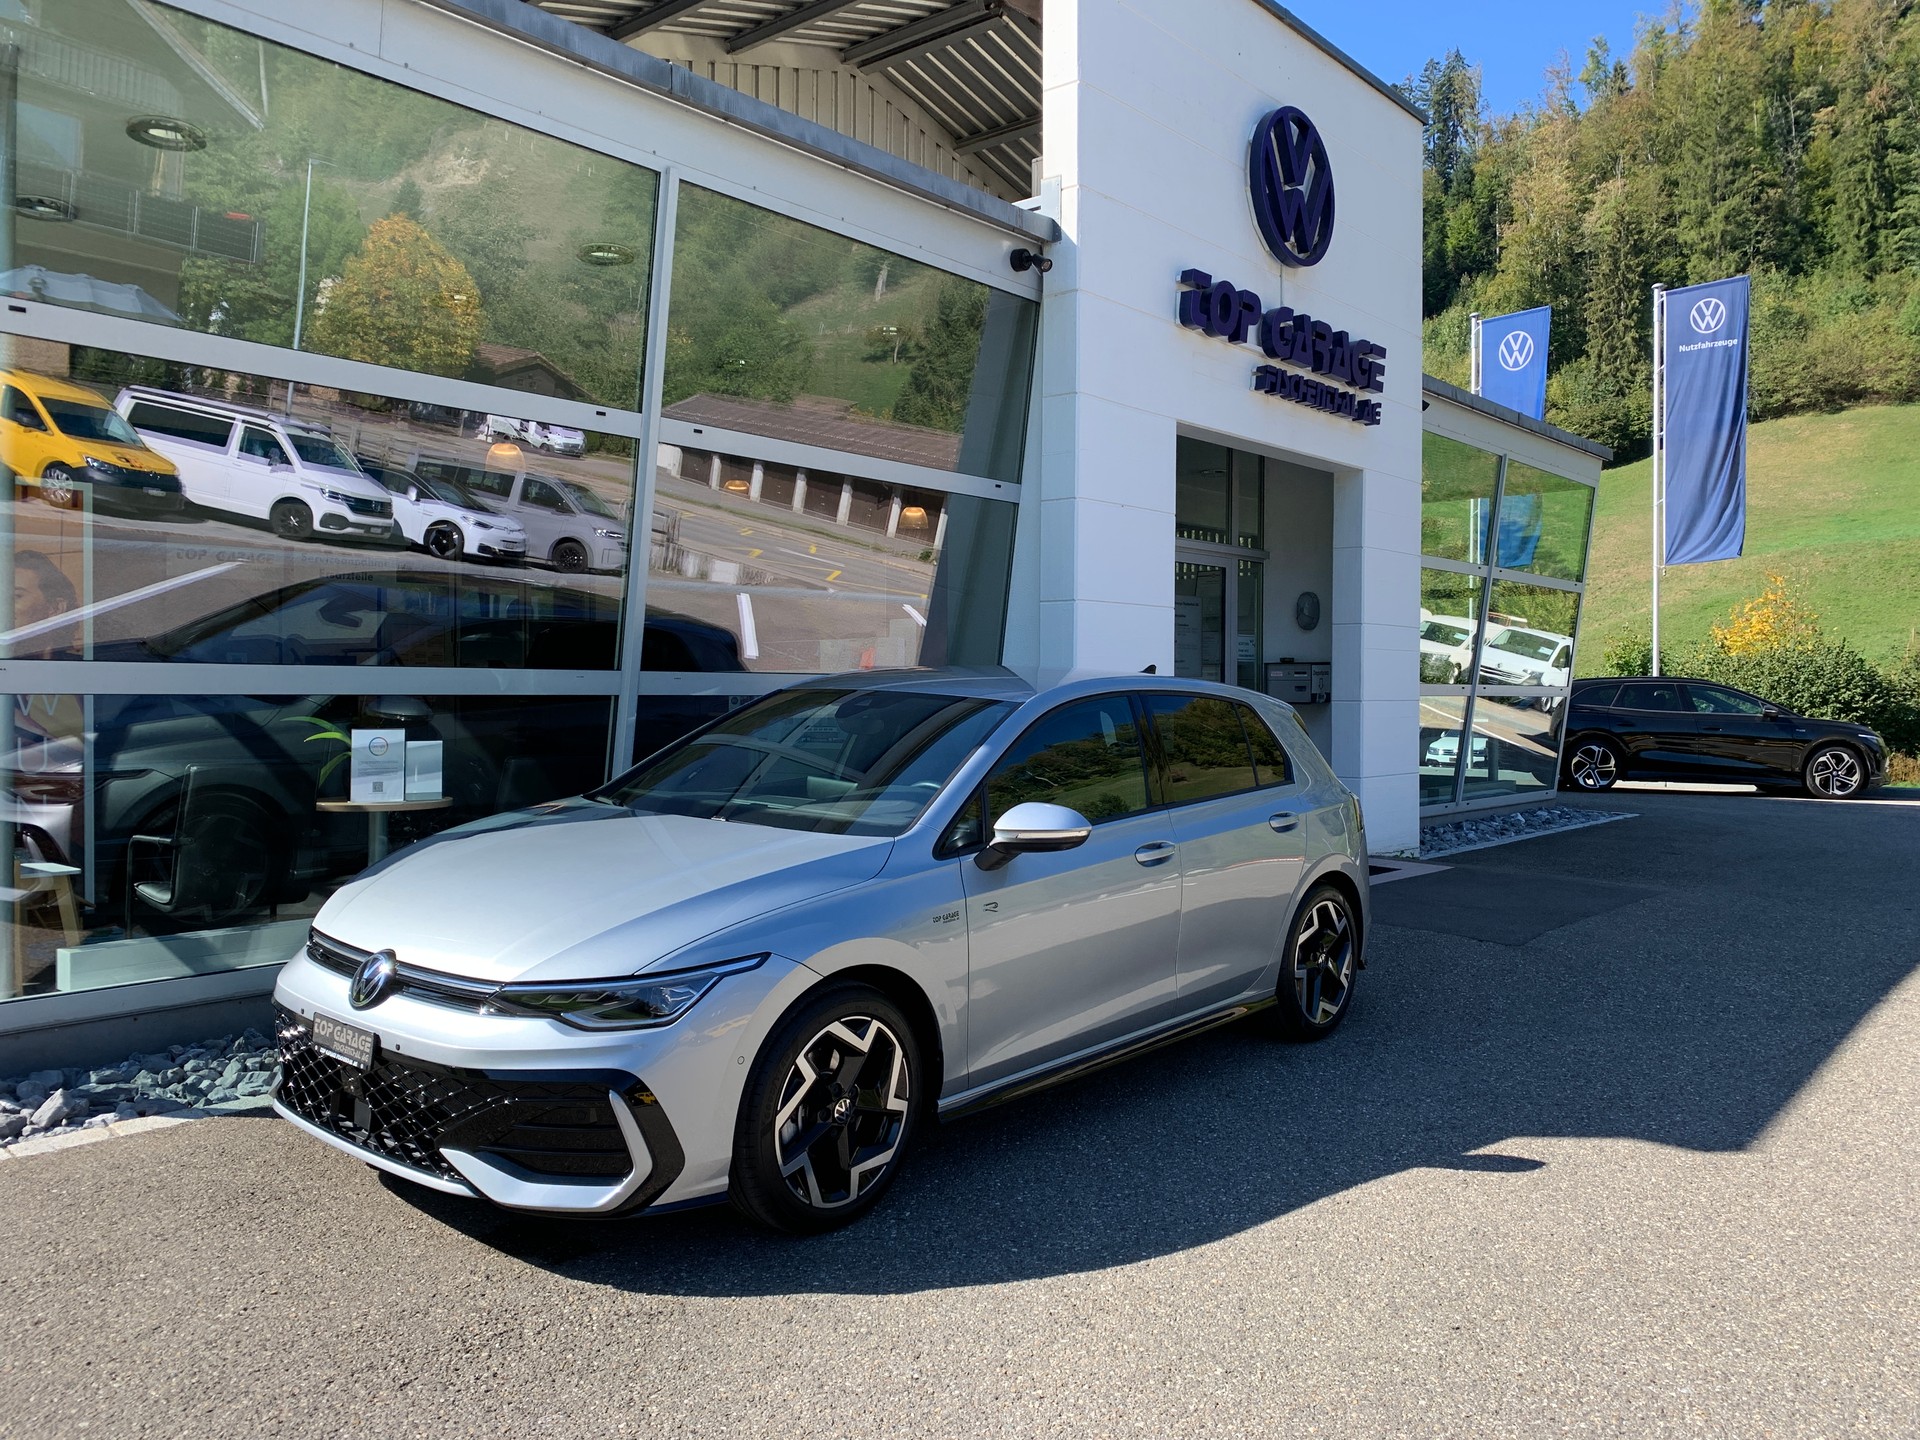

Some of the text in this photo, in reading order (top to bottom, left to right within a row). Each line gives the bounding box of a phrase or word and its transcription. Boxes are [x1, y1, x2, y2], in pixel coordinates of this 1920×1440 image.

[1252, 106, 1335, 267] VW
[1177, 268, 1387, 393] TOP GARAGE
[1690, 298, 1726, 334] VW
[1499, 331, 1534, 371] VW
[1678, 338, 1739, 353] Nutzfahrzeuge
[313, 1017, 373, 1053] TOP GARAGE
